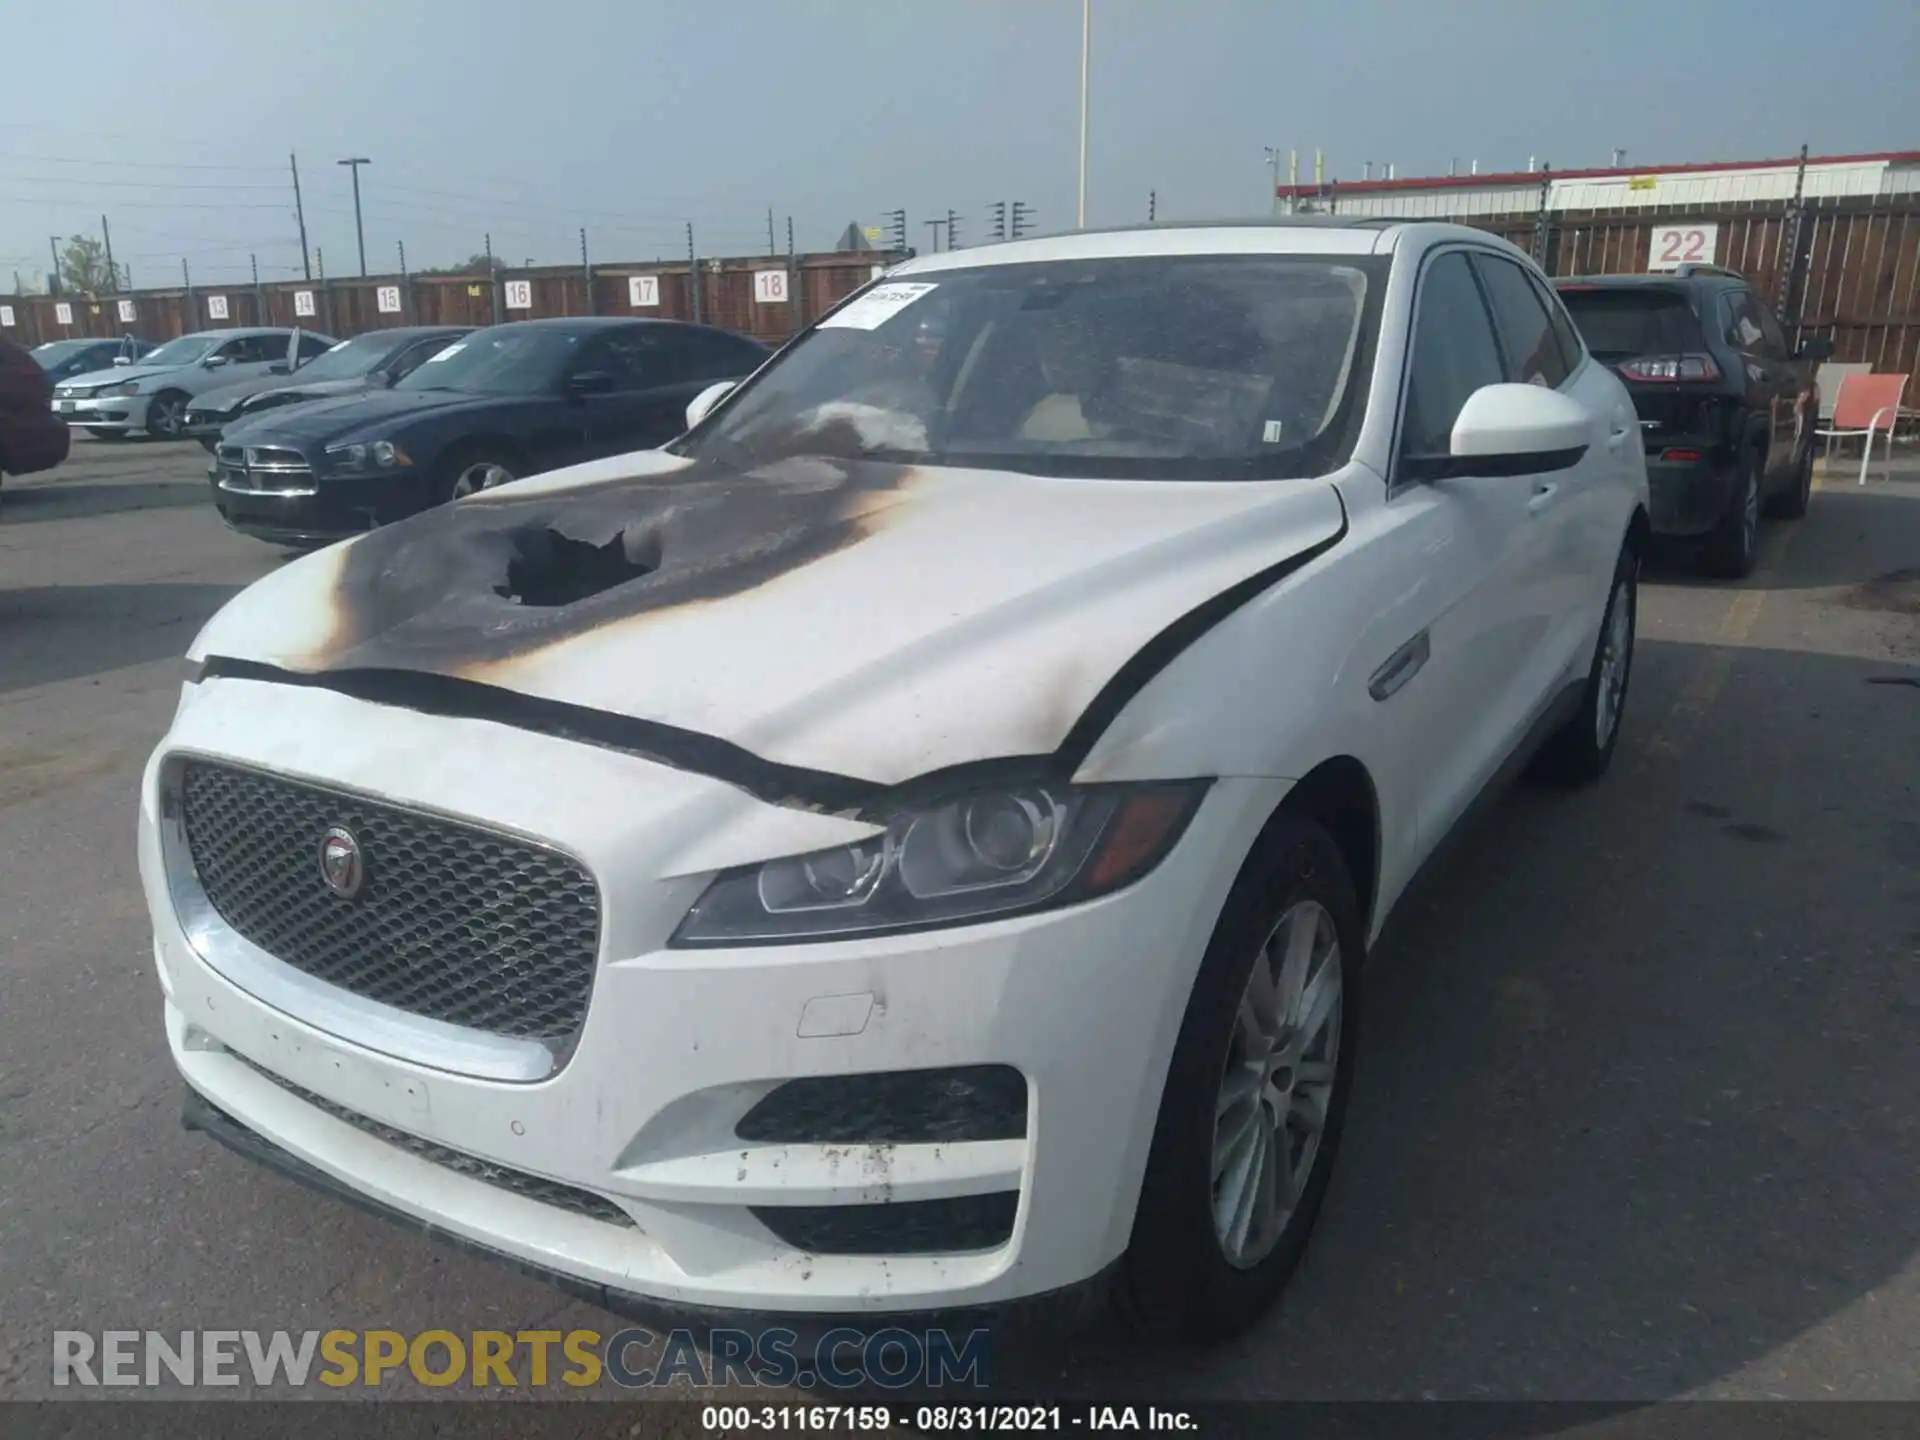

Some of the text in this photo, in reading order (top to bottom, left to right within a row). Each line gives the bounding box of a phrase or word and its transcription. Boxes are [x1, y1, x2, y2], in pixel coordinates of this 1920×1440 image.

[1660, 230, 1705, 261] 22
[509, 284, 527, 304] 16
[633, 281, 654, 302] 17
[760, 275, 782, 297] 18
[211, 298, 226, 315] 13
[381, 289, 397, 309] 15
